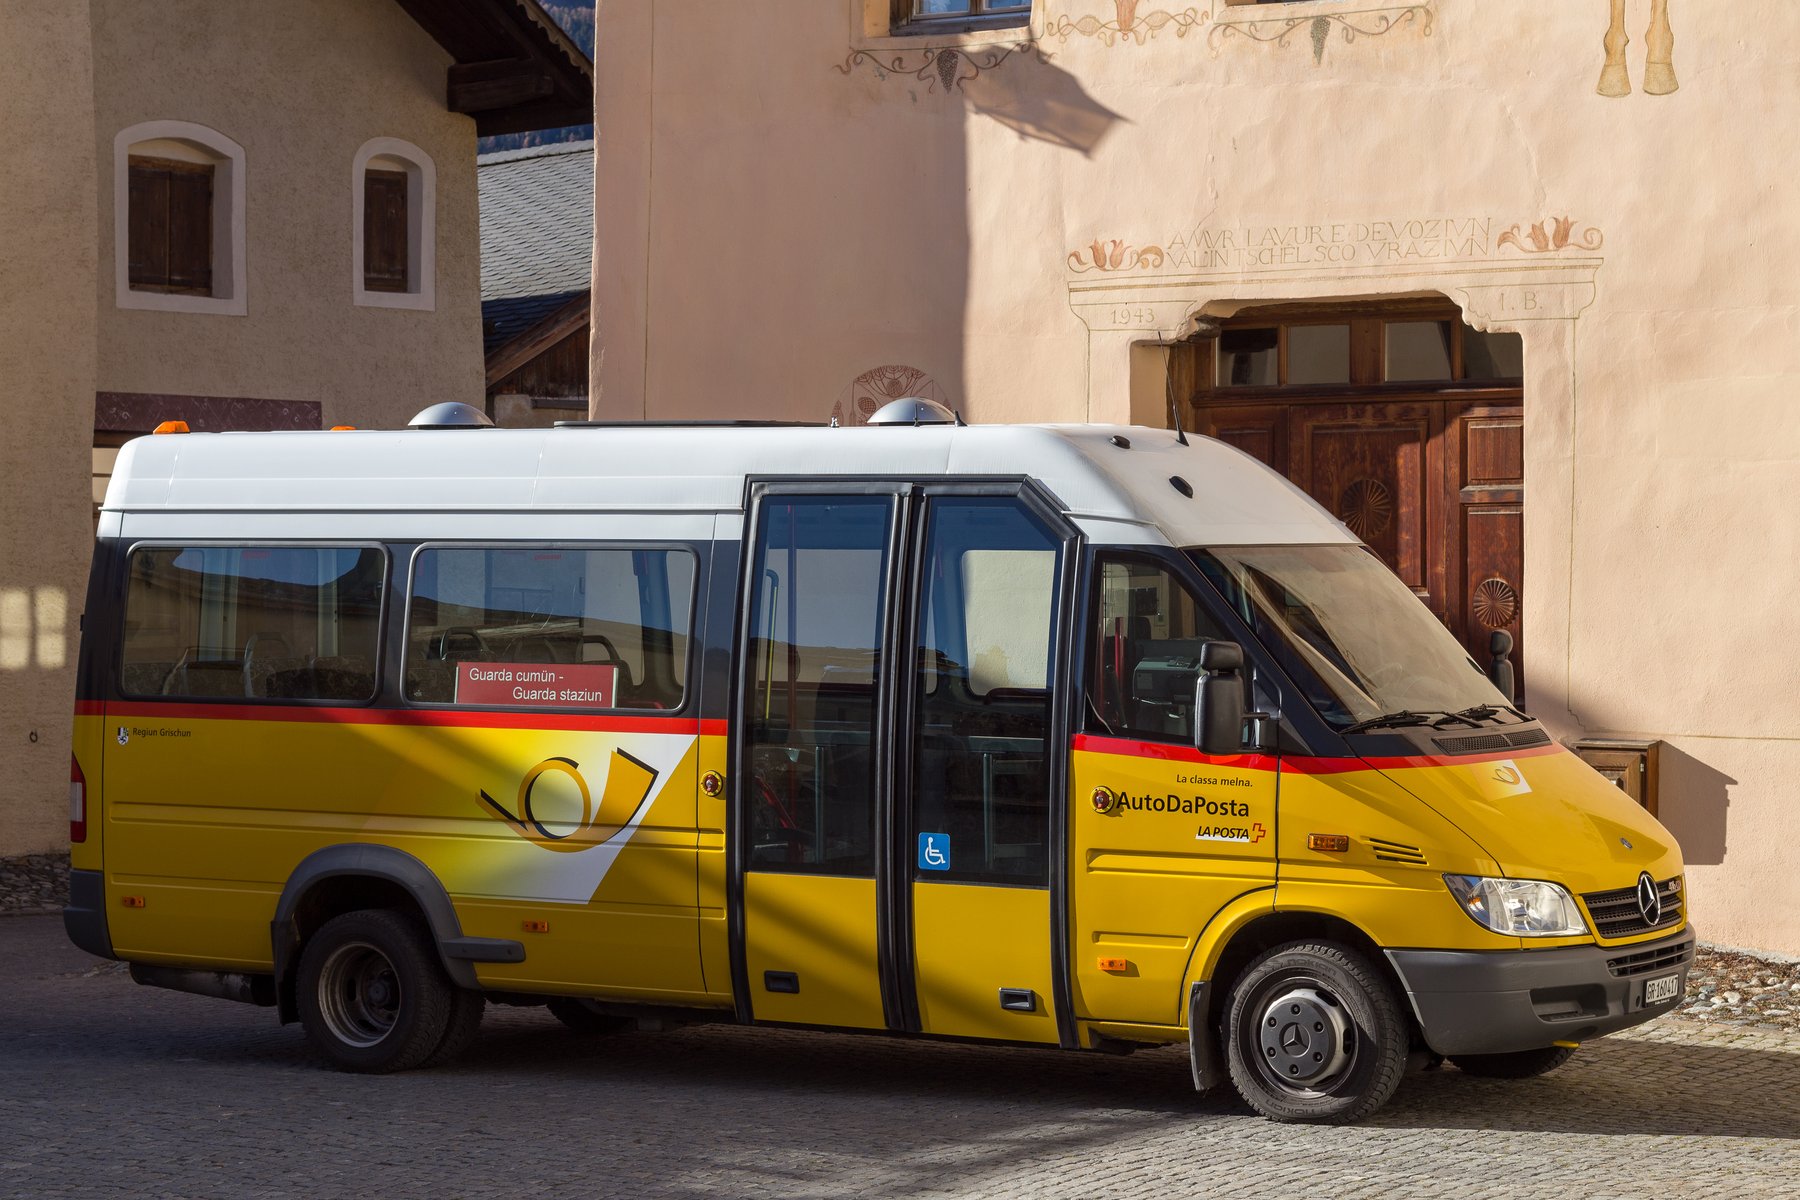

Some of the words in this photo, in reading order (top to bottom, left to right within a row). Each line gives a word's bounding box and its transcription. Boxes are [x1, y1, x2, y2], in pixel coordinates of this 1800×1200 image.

[1109, 306, 1156, 326] 1943
[469, 667, 513, 682] Guarda
[516, 669, 556, 683] cumün
[512, 686, 557, 701] Guarda
[559, 688, 602, 702] staziun
[132, 727, 158, 738] Regiun
[159, 727, 192, 737] Grischun
[1176, 774, 1187, 783] La
[1189, 775, 1218, 785] classa
[1116, 791, 1249, 817] AutoDaPosta
[1197, 825, 1211, 837] LA
[1212, 826, 1250, 840] POSTA
